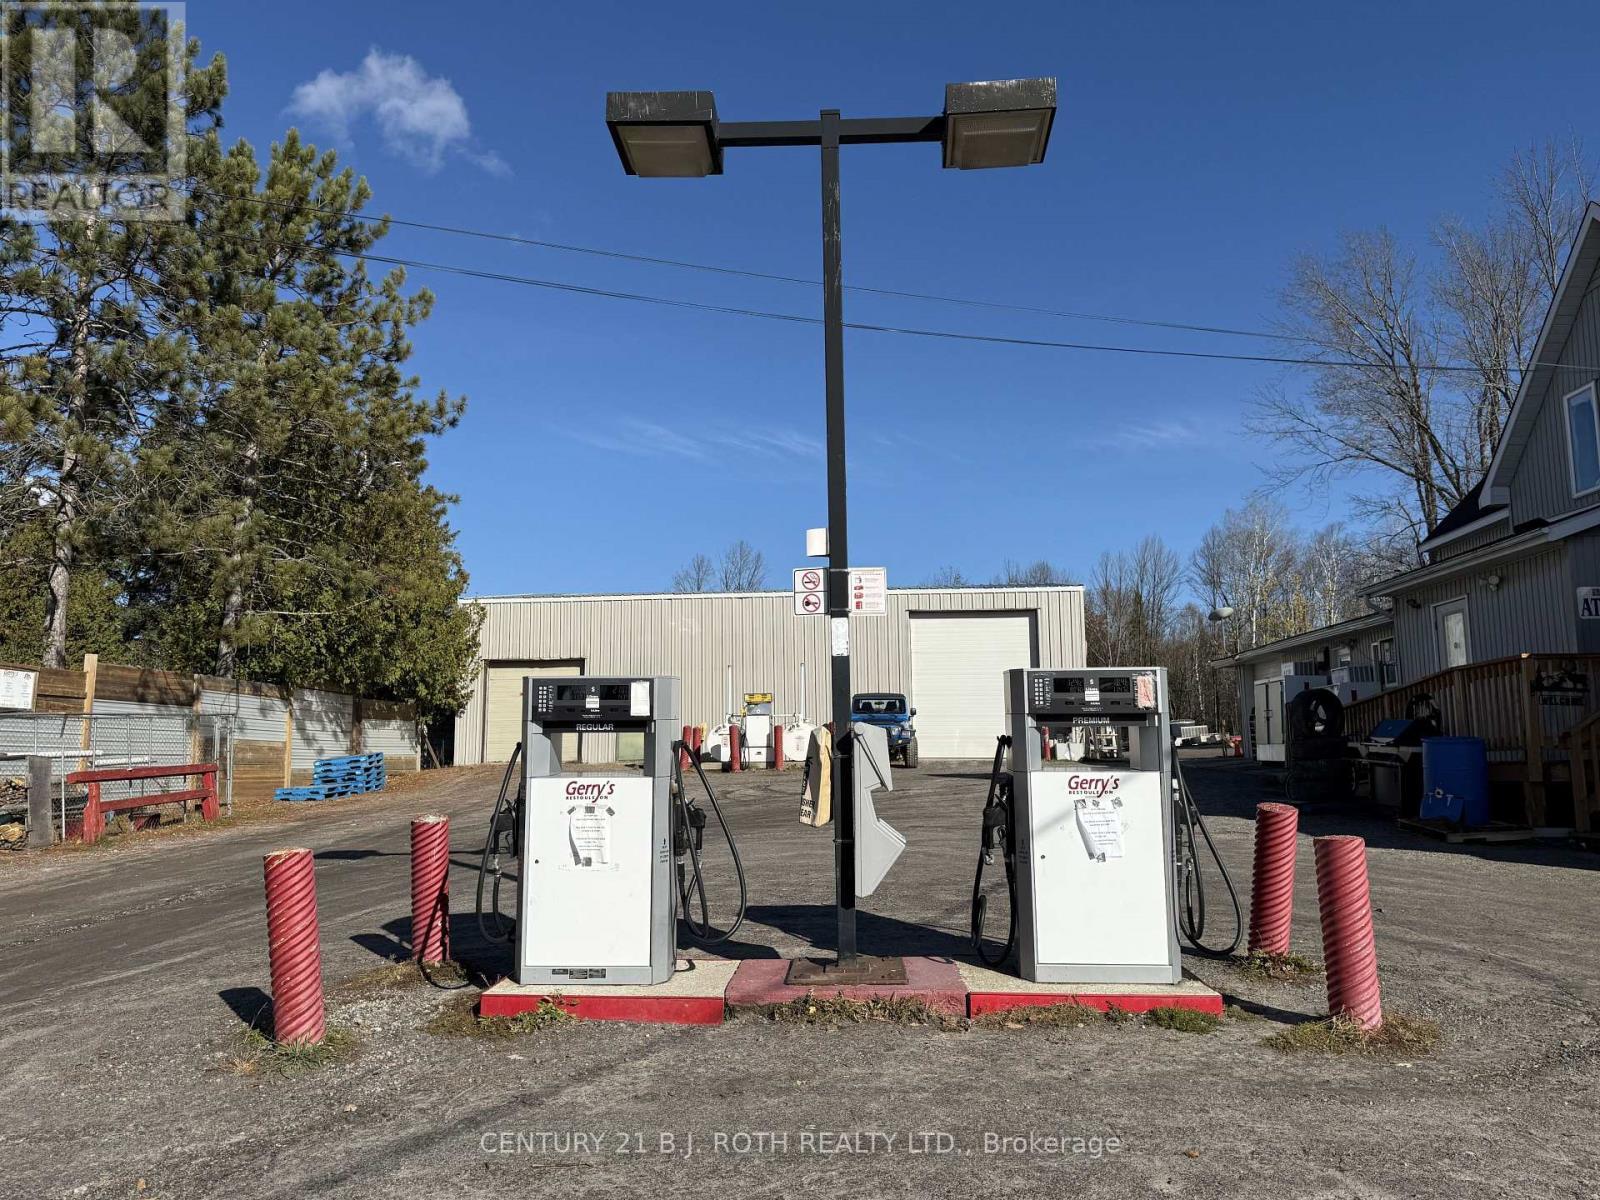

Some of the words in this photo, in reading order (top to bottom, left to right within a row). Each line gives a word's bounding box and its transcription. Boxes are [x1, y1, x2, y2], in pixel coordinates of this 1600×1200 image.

[576, 723, 614, 731] REGULAR
[566, 780, 616, 803] Gerry's
[1068, 775, 1120, 798] Gerry's
